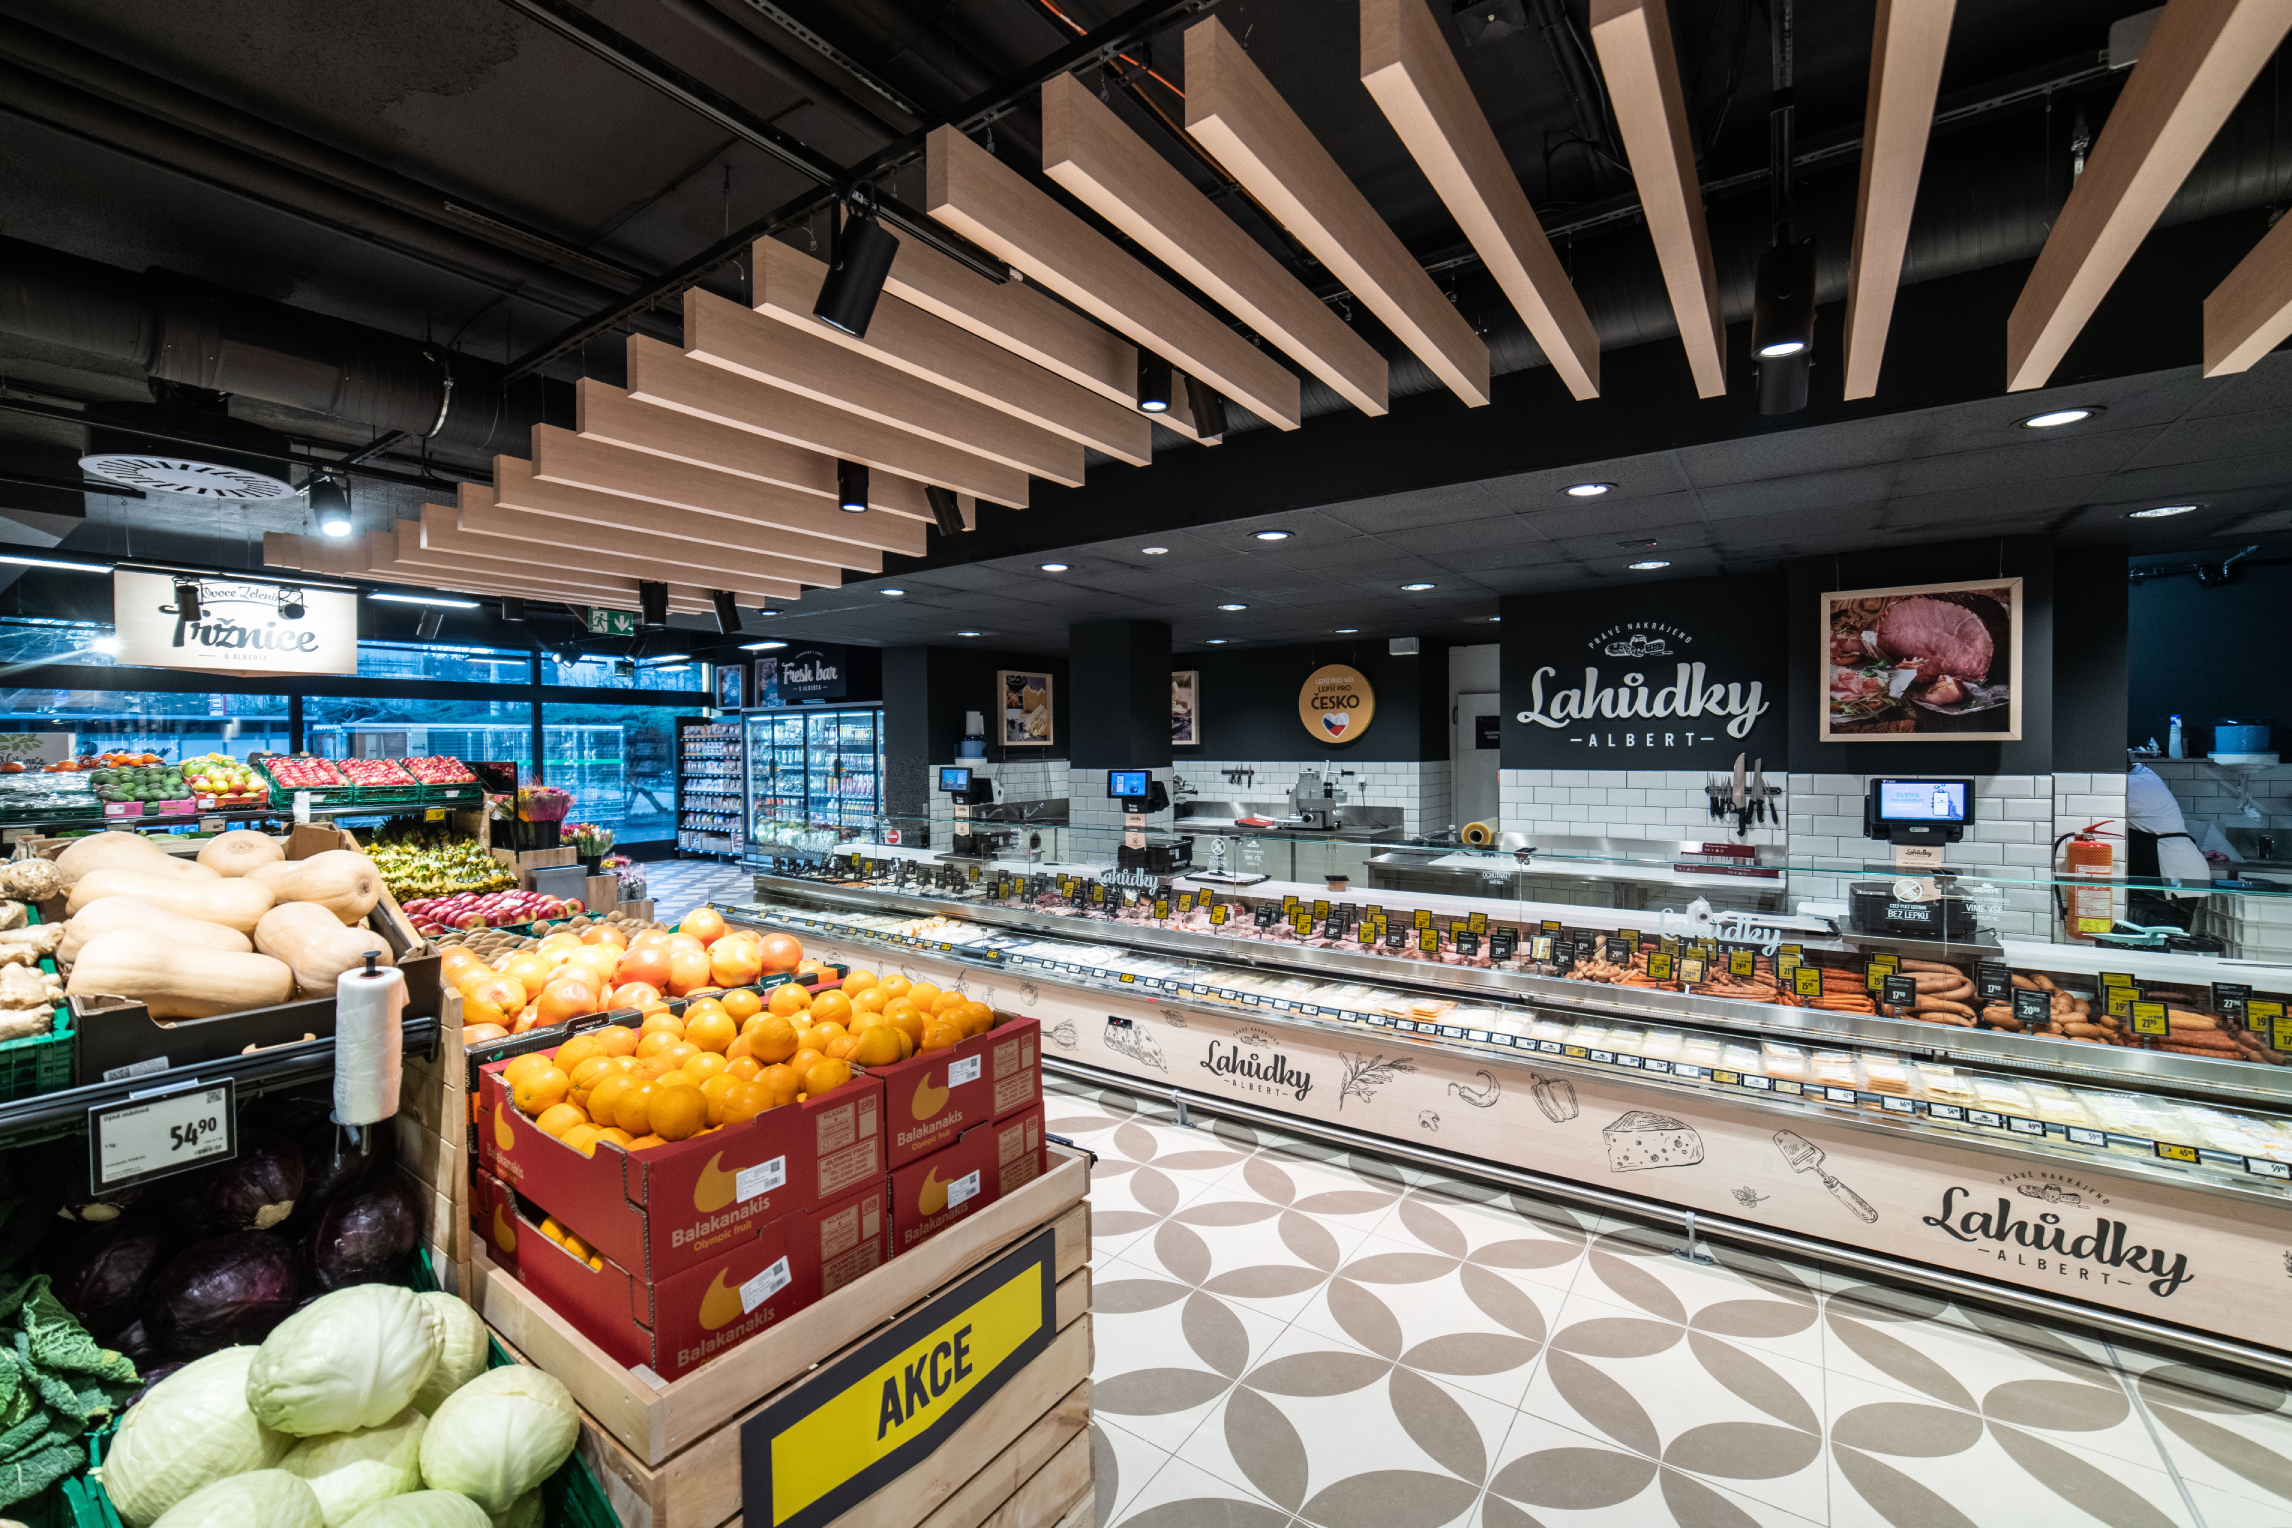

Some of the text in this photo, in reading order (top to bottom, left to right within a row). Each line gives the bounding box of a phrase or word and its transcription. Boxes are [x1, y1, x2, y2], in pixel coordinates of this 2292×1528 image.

[202, 586, 284, 602] Ovoce Zelenin
[1627, 622, 1692, 644] NAKRÁJENO
[233, 653, 267, 661] ALBERTA
[781, 660, 838, 685] Fresh bar
[1317, 684, 1352, 693] LEPŠÍ PRO
[1311, 692, 1360, 710] ČESKO
[1516, 661, 1769, 739] Lahůdky
[1588, 732, 1695, 747] ALBERT
[1094, 866, 1160, 896] Lahůdky
[1972, 886, 1999, 894] albert
[1888, 909, 1929, 920] BEZ LEPKU
[1966, 903, 1986, 913] VÍME
[1649, 907, 1783, 957] Lahůdky
[1687, 942, 1746, 954] ALBERT
[1801, 981, 1814, 990] 1590
[1987, 984, 2002, 994] 1790
[1892, 990, 1906, 1000] 1790
[2223, 999, 2241, 1009] 2790
[2022, 1005, 2041, 1016] 2090
[2142, 1018, 2157, 1029] 2190
[1200, 1039, 1314, 1102] Lahůdky
[1232, 1079, 1280, 1097] ALBERT
[897, 1110, 963, 1147] Balakanakis
[1973, 1115, 1994, 1124] albert
[2028, 1122, 2041, 1130] 4990
[170, 1116, 217, 1152] 5490
[911, 1129, 951, 1151] Olympic fruit
[2088, 1132, 2102, 1141] 5990
[486, 1142, 524, 1180] Balakanakis
[825, 1143, 871, 1166] OLYMPIC FRUIT
[2179, 1148, 2193, 1157] 4590
[2271, 1164, 2287, 1173] 5990
[2041, 1172, 2110, 1205] NAKRÁJENO
[671, 1195, 771, 1248] Balakanakis
[904, 1200, 969, 1245] Balakanakis
[693, 1219, 753, 1252] Olympic fruit
[1922, 1186, 2195, 1298] Lahůdky
[1997, 1250, 2111, 1286] ALBERT
[677, 1307, 775, 1368] Balakanakis
[876, 1323, 973, 1442] AKCE
